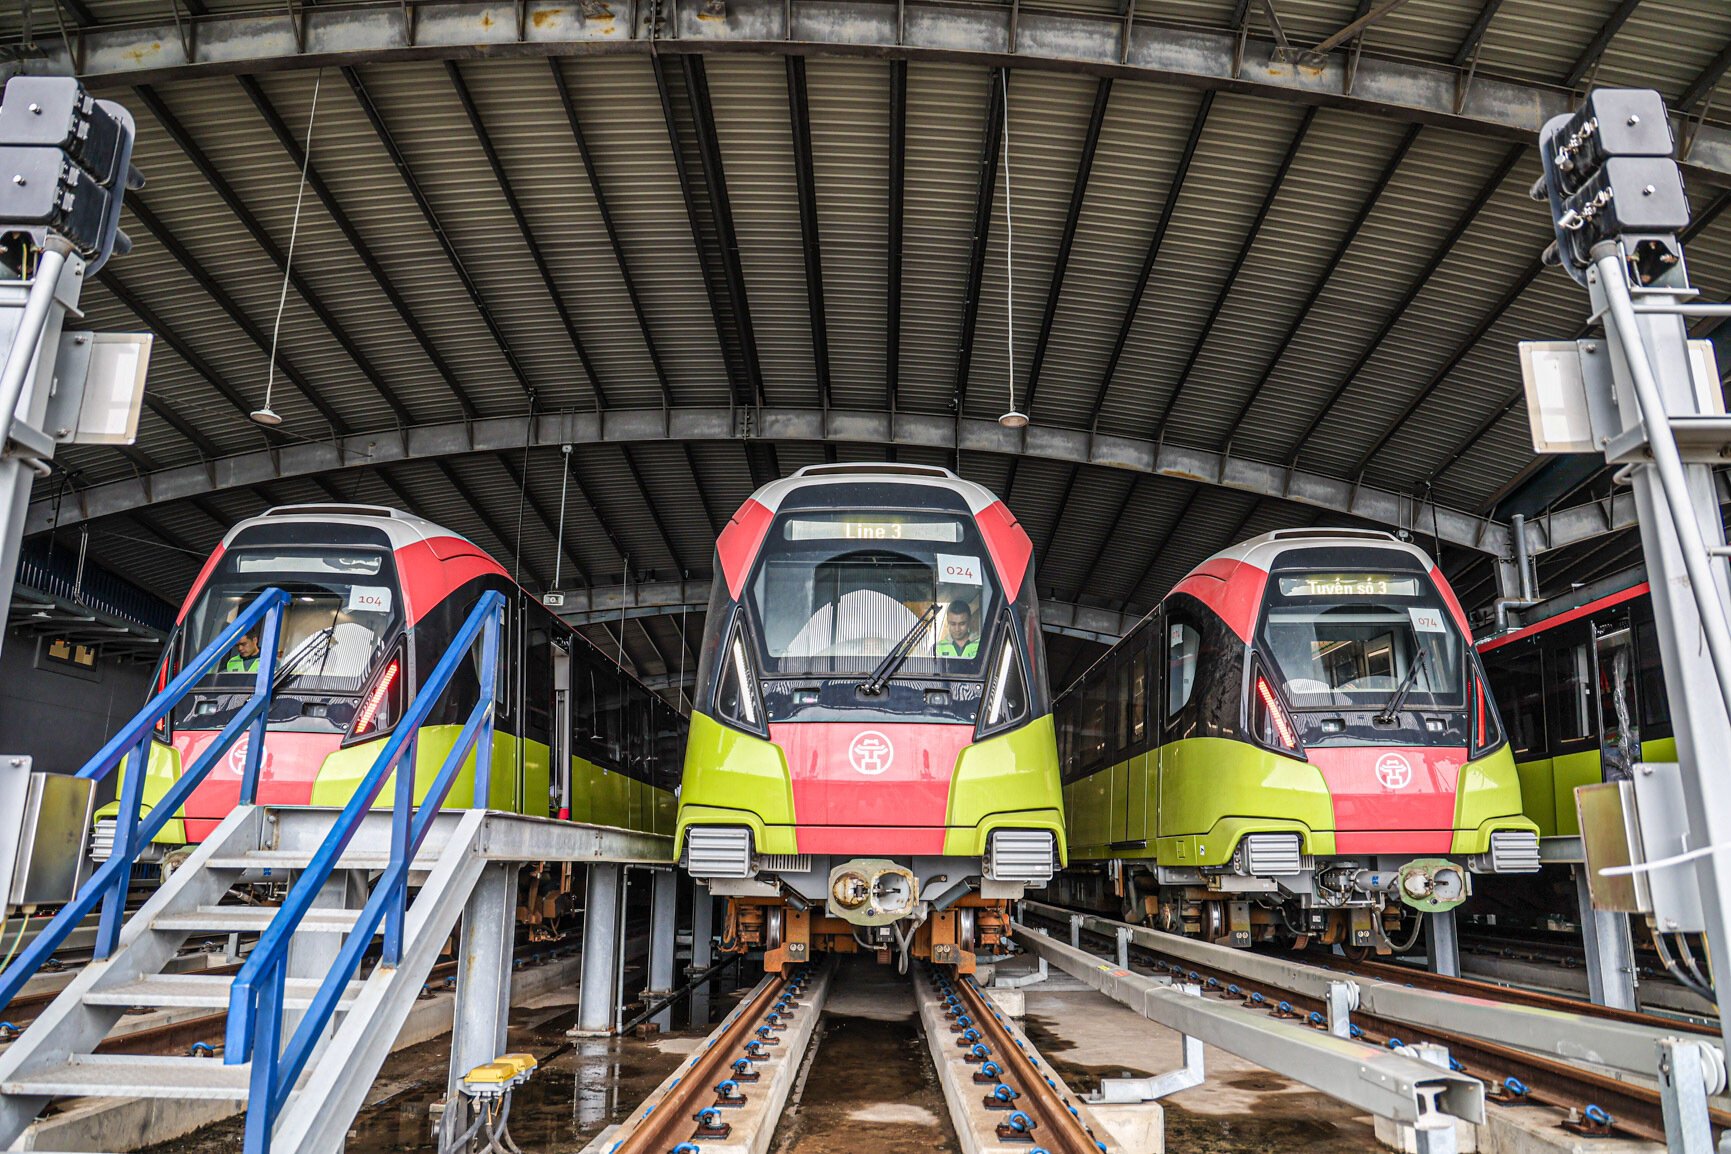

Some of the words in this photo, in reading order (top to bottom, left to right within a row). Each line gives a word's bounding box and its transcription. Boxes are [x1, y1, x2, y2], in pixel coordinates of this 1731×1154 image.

[846, 523, 886, 539] Line
[891, 523, 902, 539] 3
[946, 566, 973, 579] 024
[1378, 581, 1387, 595] 3
[358, 595, 382, 607] 104
[1418, 617, 1438, 628] 074
